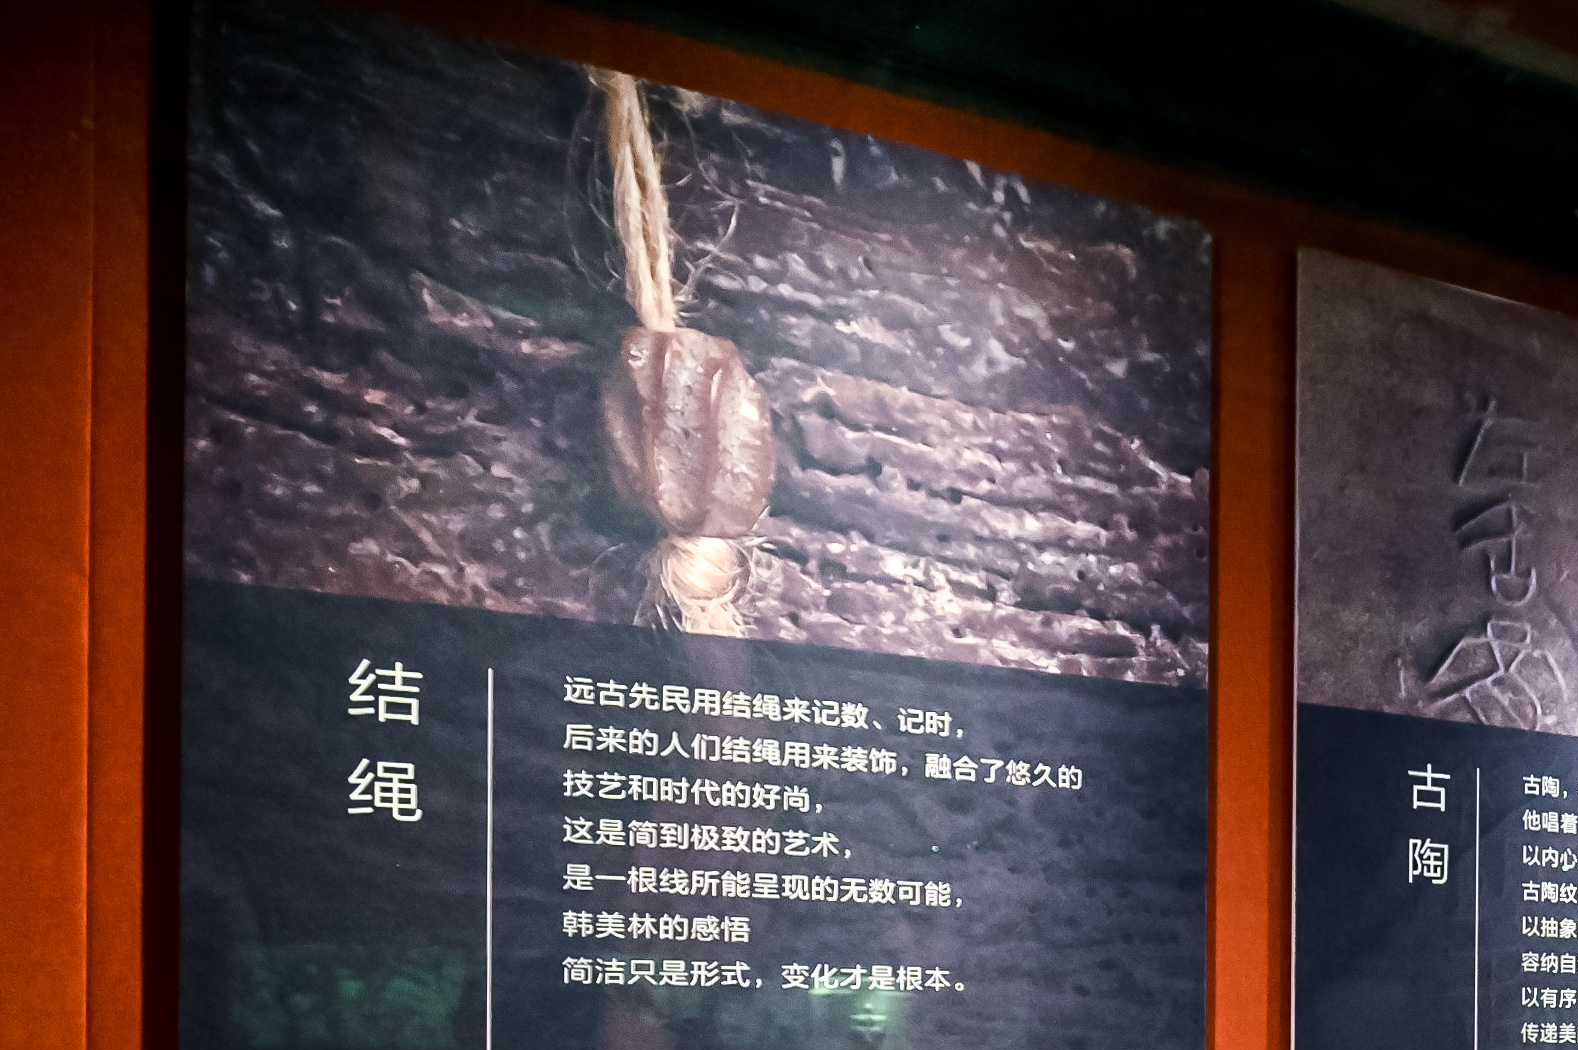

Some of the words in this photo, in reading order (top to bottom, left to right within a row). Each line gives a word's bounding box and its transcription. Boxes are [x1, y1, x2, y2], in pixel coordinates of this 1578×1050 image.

[563, 675, 964, 739] 远古先民用结绳来记数、记时，
[347, 658, 424, 822] 结绳
[563, 723, 1083, 790] 后来的人们结绳用来装饰，融合了悠久的
[562, 769, 823, 814] 技艺和时代的好尚，
[562, 816, 852, 859] 这是简到极致的艺术，
[1407, 763, 1451, 885] 古陶
[562, 863, 963, 908] 是一根线所能呈现的无数可能，
[562, 909, 751, 943] 韩美林的感悟
[562, 956, 965, 993] 简洁只是形式，变化才是根本。
